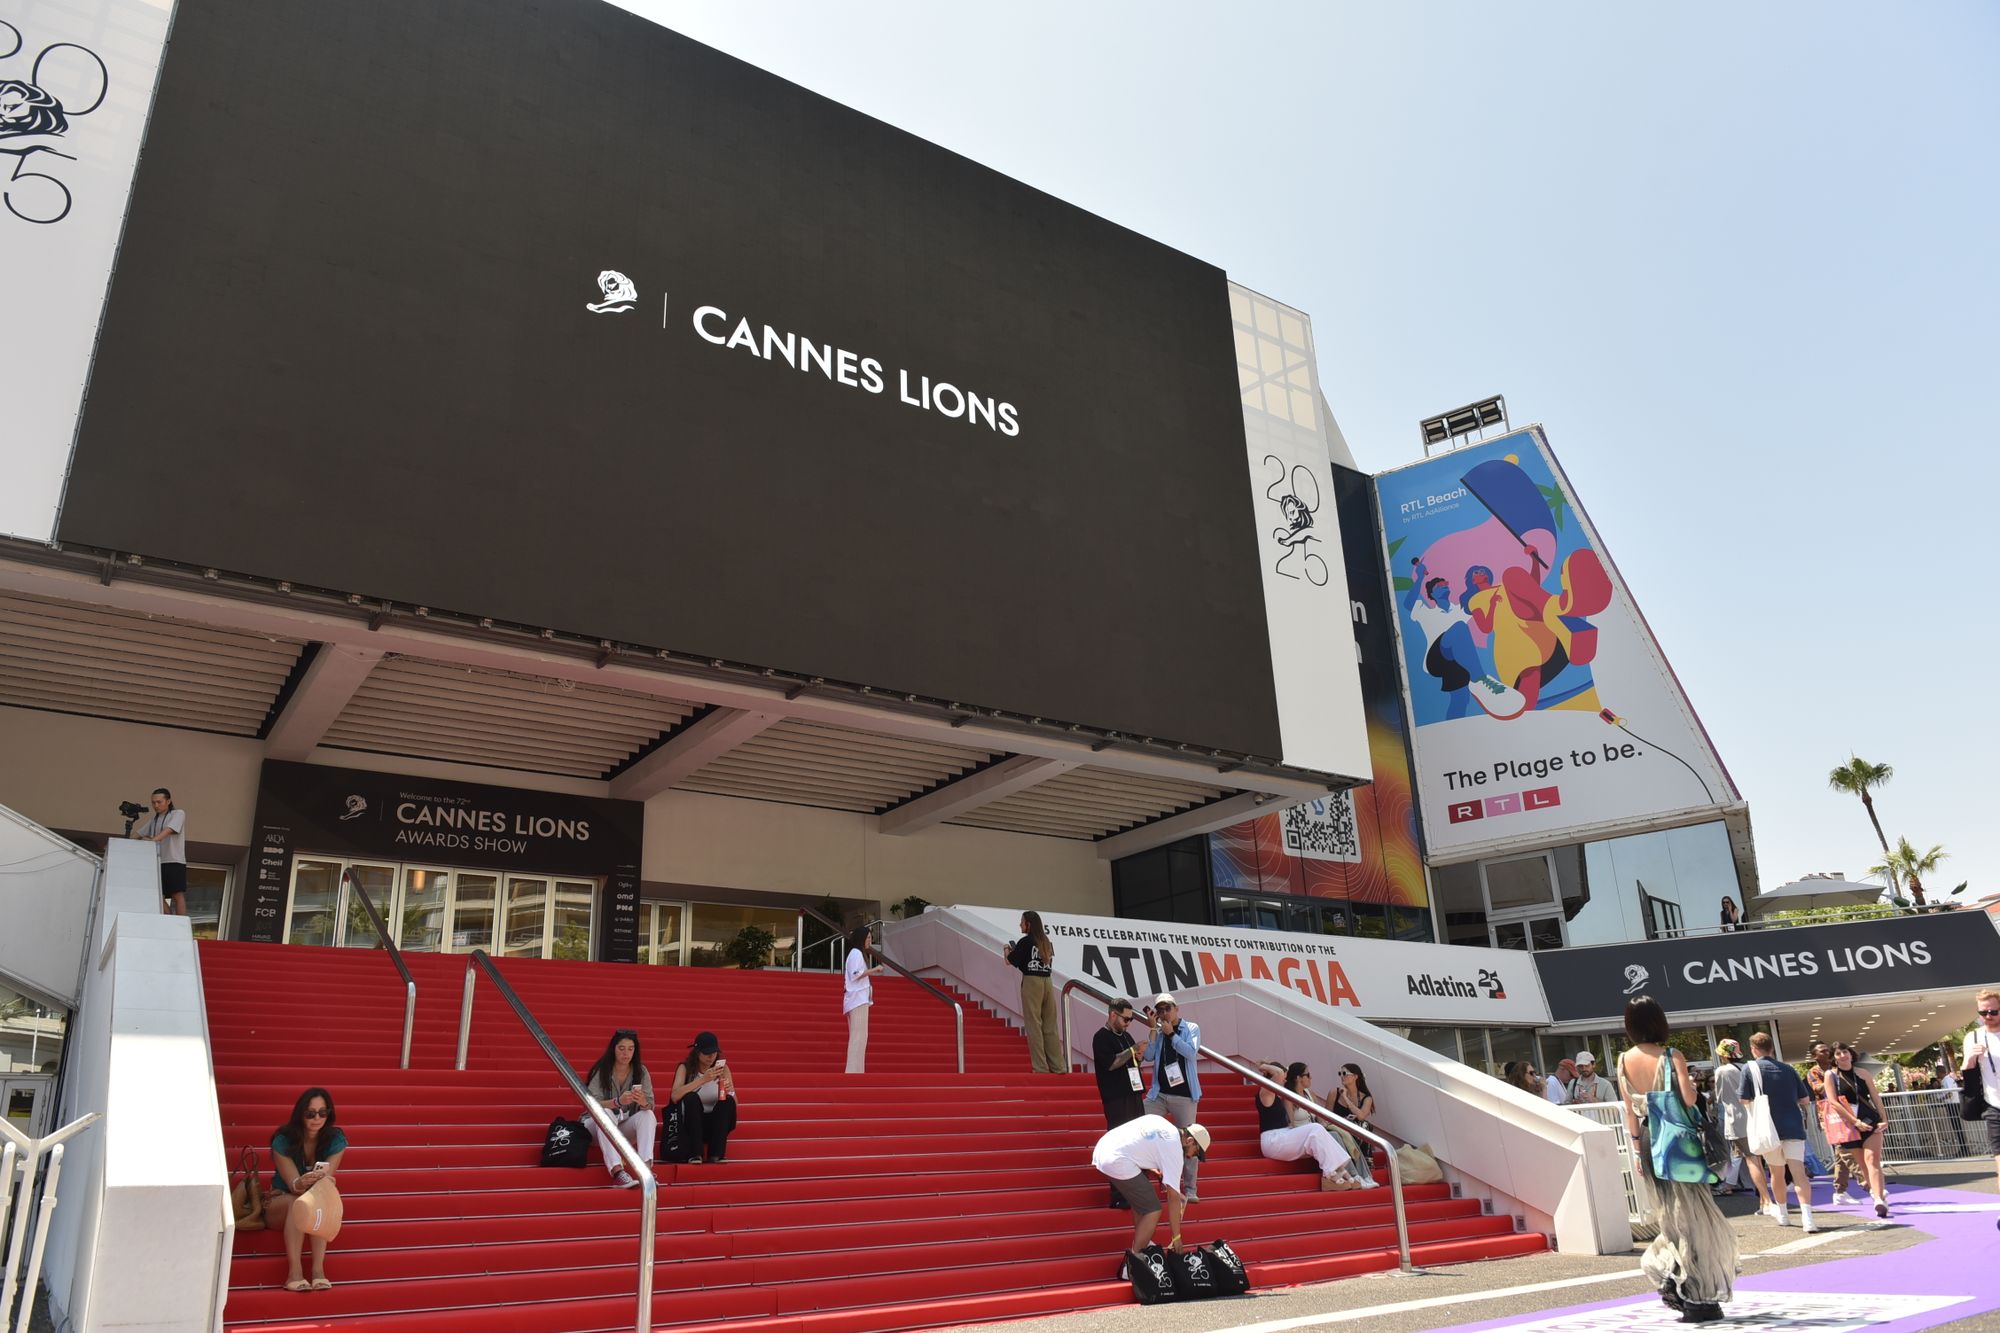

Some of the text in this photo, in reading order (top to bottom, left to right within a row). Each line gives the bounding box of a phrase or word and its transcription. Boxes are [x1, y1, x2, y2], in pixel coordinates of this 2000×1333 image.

[693, 306, 1020, 437] CANNES LIONS
[1400, 487, 1467, 514] RTL Beach
[1411, 512, 1424, 521] RTL
[1443, 743, 1643, 790] The Plage to be.
[400, 791, 432, 802] Welcome
[443, 796, 455, 804] the
[1455, 792, 1552, 820] RTL
[396, 803, 590, 841] CANNES LIONS
[395, 829, 527, 854] AWARDS SHOW
[261, 859, 283, 867] Cheil
[255, 908, 276, 917] FCB
[1044, 924, 1337, 956] 5 YEARS CELEBRATING THE MODEST CONTRIBUTION OF THE
[1683, 940, 1932, 985] CANNES LIONS
[1406, 968, 1506, 999] Adlatina 25
